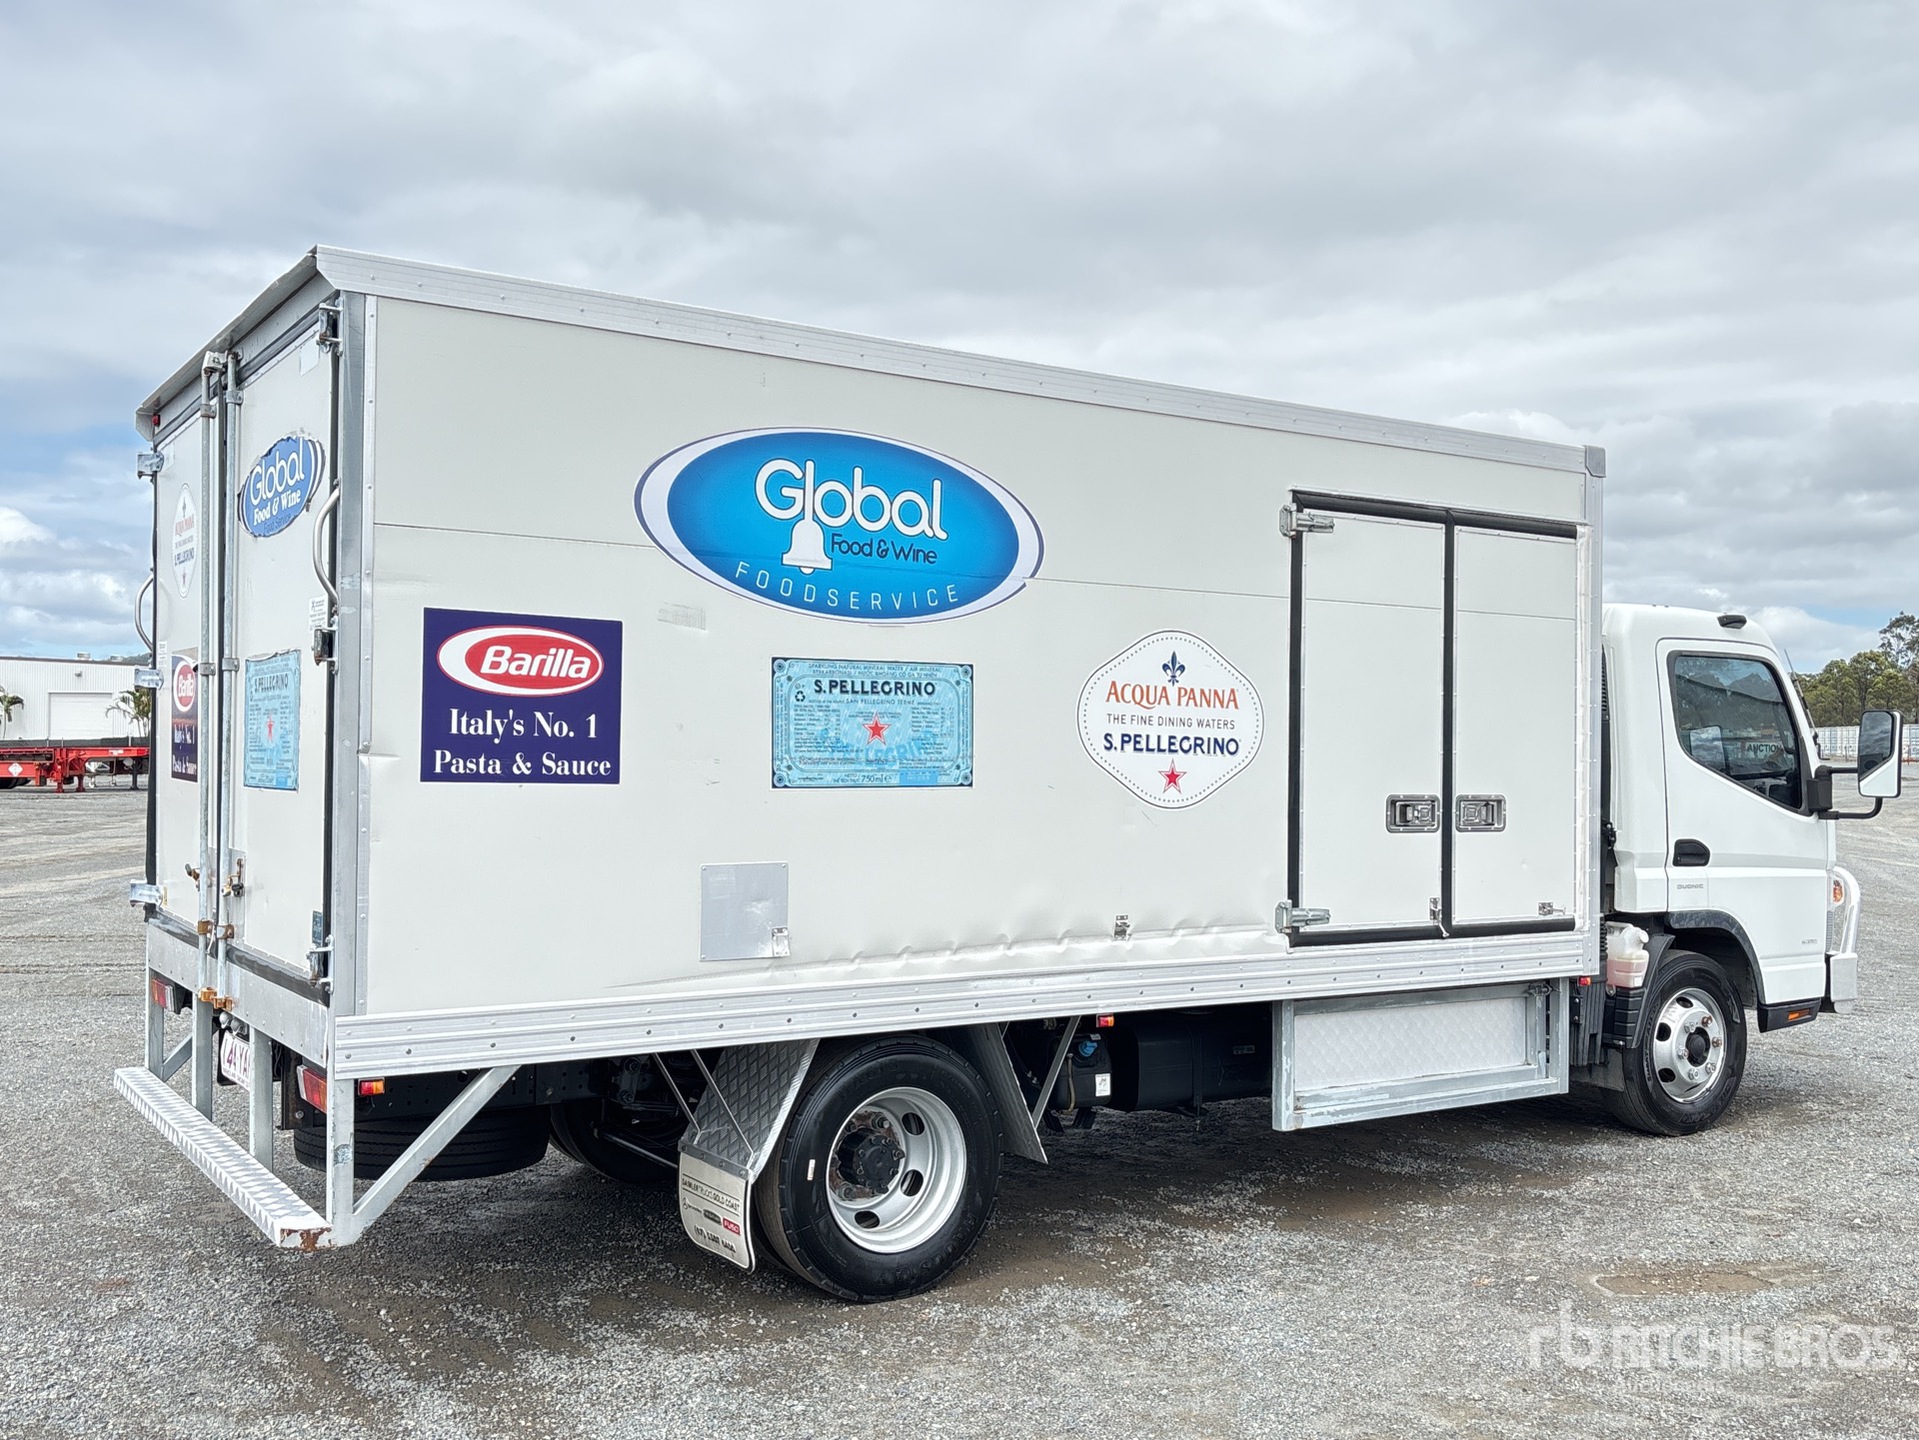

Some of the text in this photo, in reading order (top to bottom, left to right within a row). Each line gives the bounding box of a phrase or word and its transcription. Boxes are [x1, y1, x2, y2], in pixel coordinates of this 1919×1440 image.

[250, 437, 305, 506] Global
[254, 489, 301, 526] Food & Wine
[754, 458, 948, 541] Global
[831, 533, 938, 564] Food & Wine
[735, 562, 960, 610] FOODSERVICE
[480, 645, 592, 679] Barilla
[814, 679, 936, 697] S.PELLEGRINO
[1105, 680, 1239, 710] ACQUA PANNA
[449, 708, 597, 744] Italy's No. 1
[1107, 713, 1235, 730] THE FINE DINING WATERS
[1103, 732, 1240, 757] S.PELLEGRINO
[433, 749, 612, 776] Pasta & Sauce
